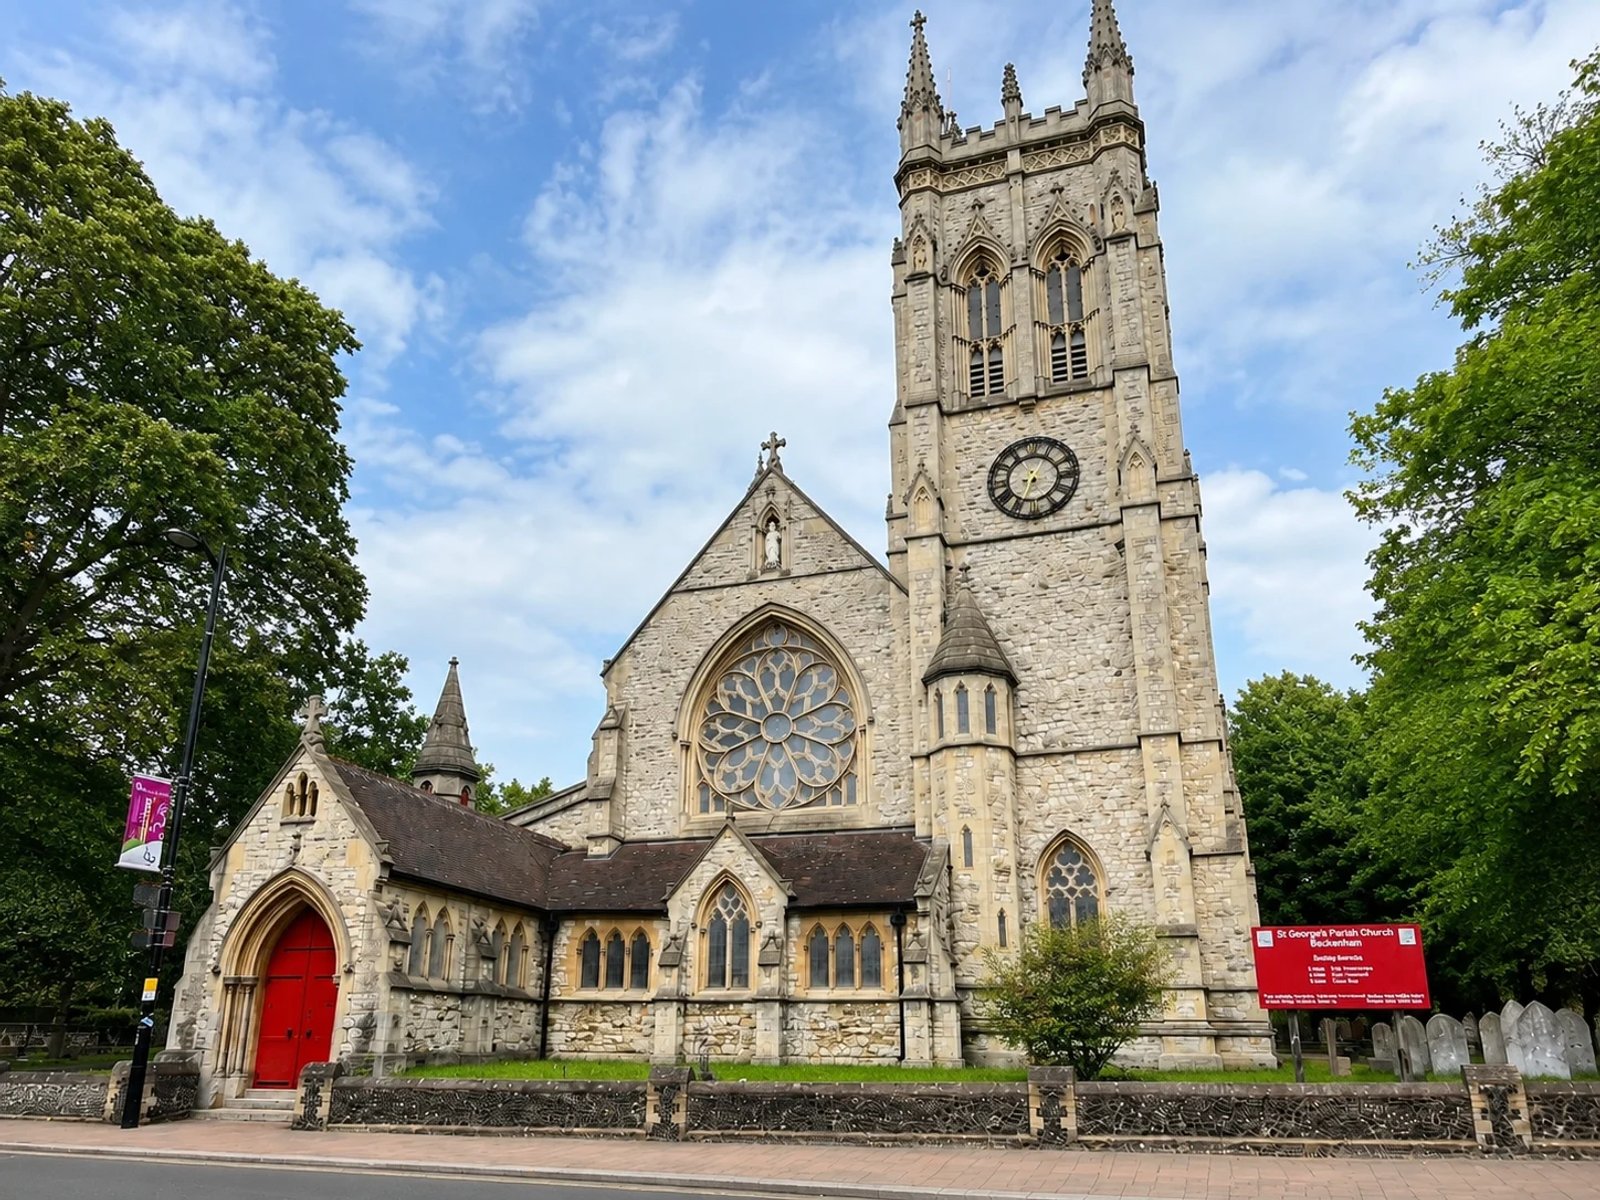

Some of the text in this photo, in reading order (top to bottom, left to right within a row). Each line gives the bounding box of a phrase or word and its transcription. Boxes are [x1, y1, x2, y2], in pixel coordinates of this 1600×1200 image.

[1277, 928, 1394, 940] St George's Parish Church
